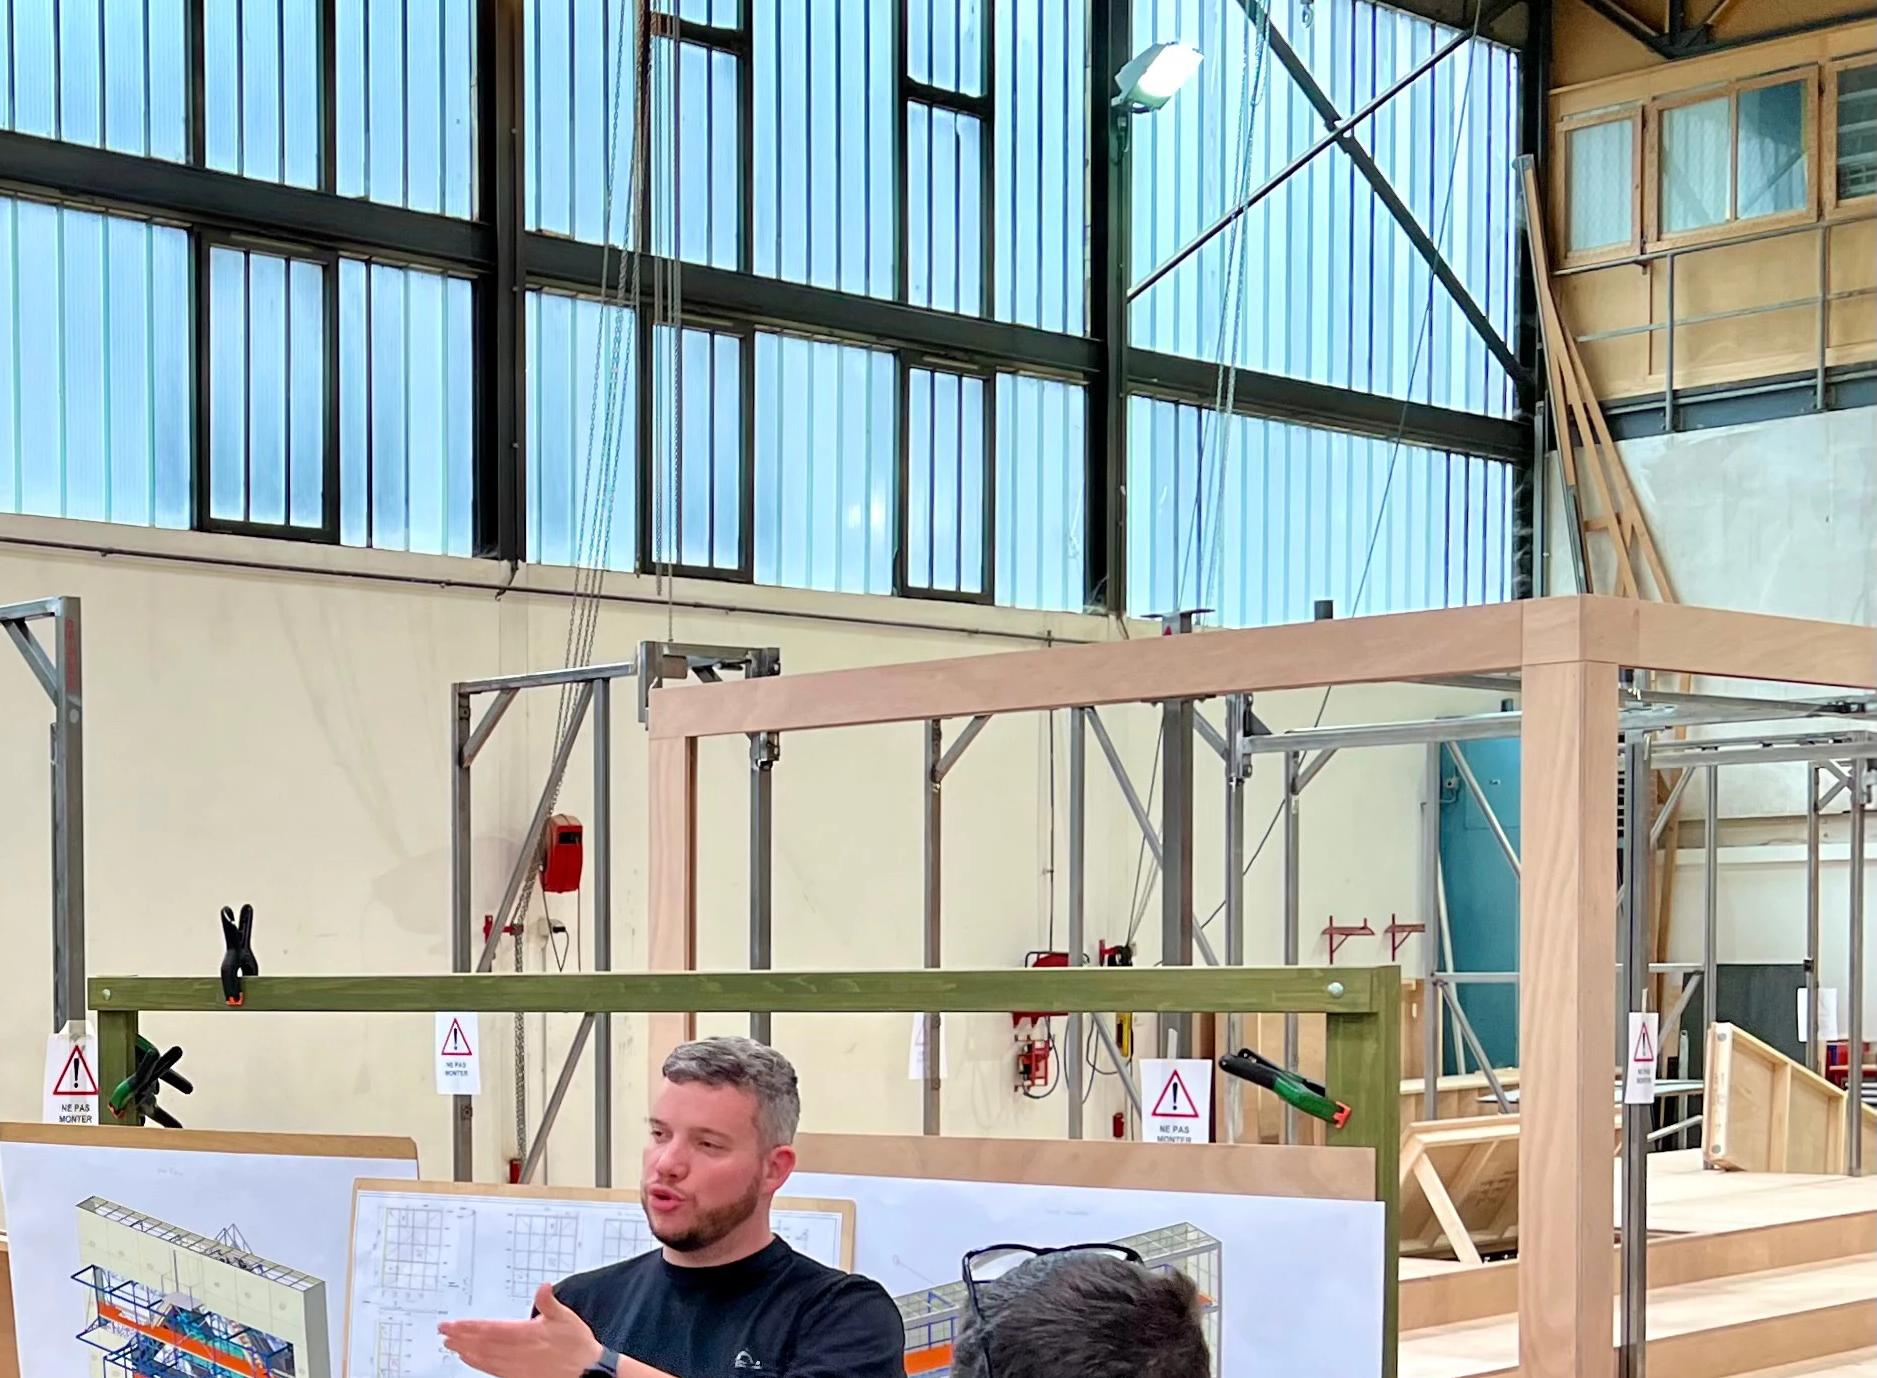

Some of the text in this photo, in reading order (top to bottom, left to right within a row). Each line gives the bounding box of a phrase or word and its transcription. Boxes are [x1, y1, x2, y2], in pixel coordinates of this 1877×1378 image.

[62, 1104, 90, 1112] NE PAS
[59, 1115, 92, 1123] MONTER
[1160, 1125, 1170, 1133] NE
